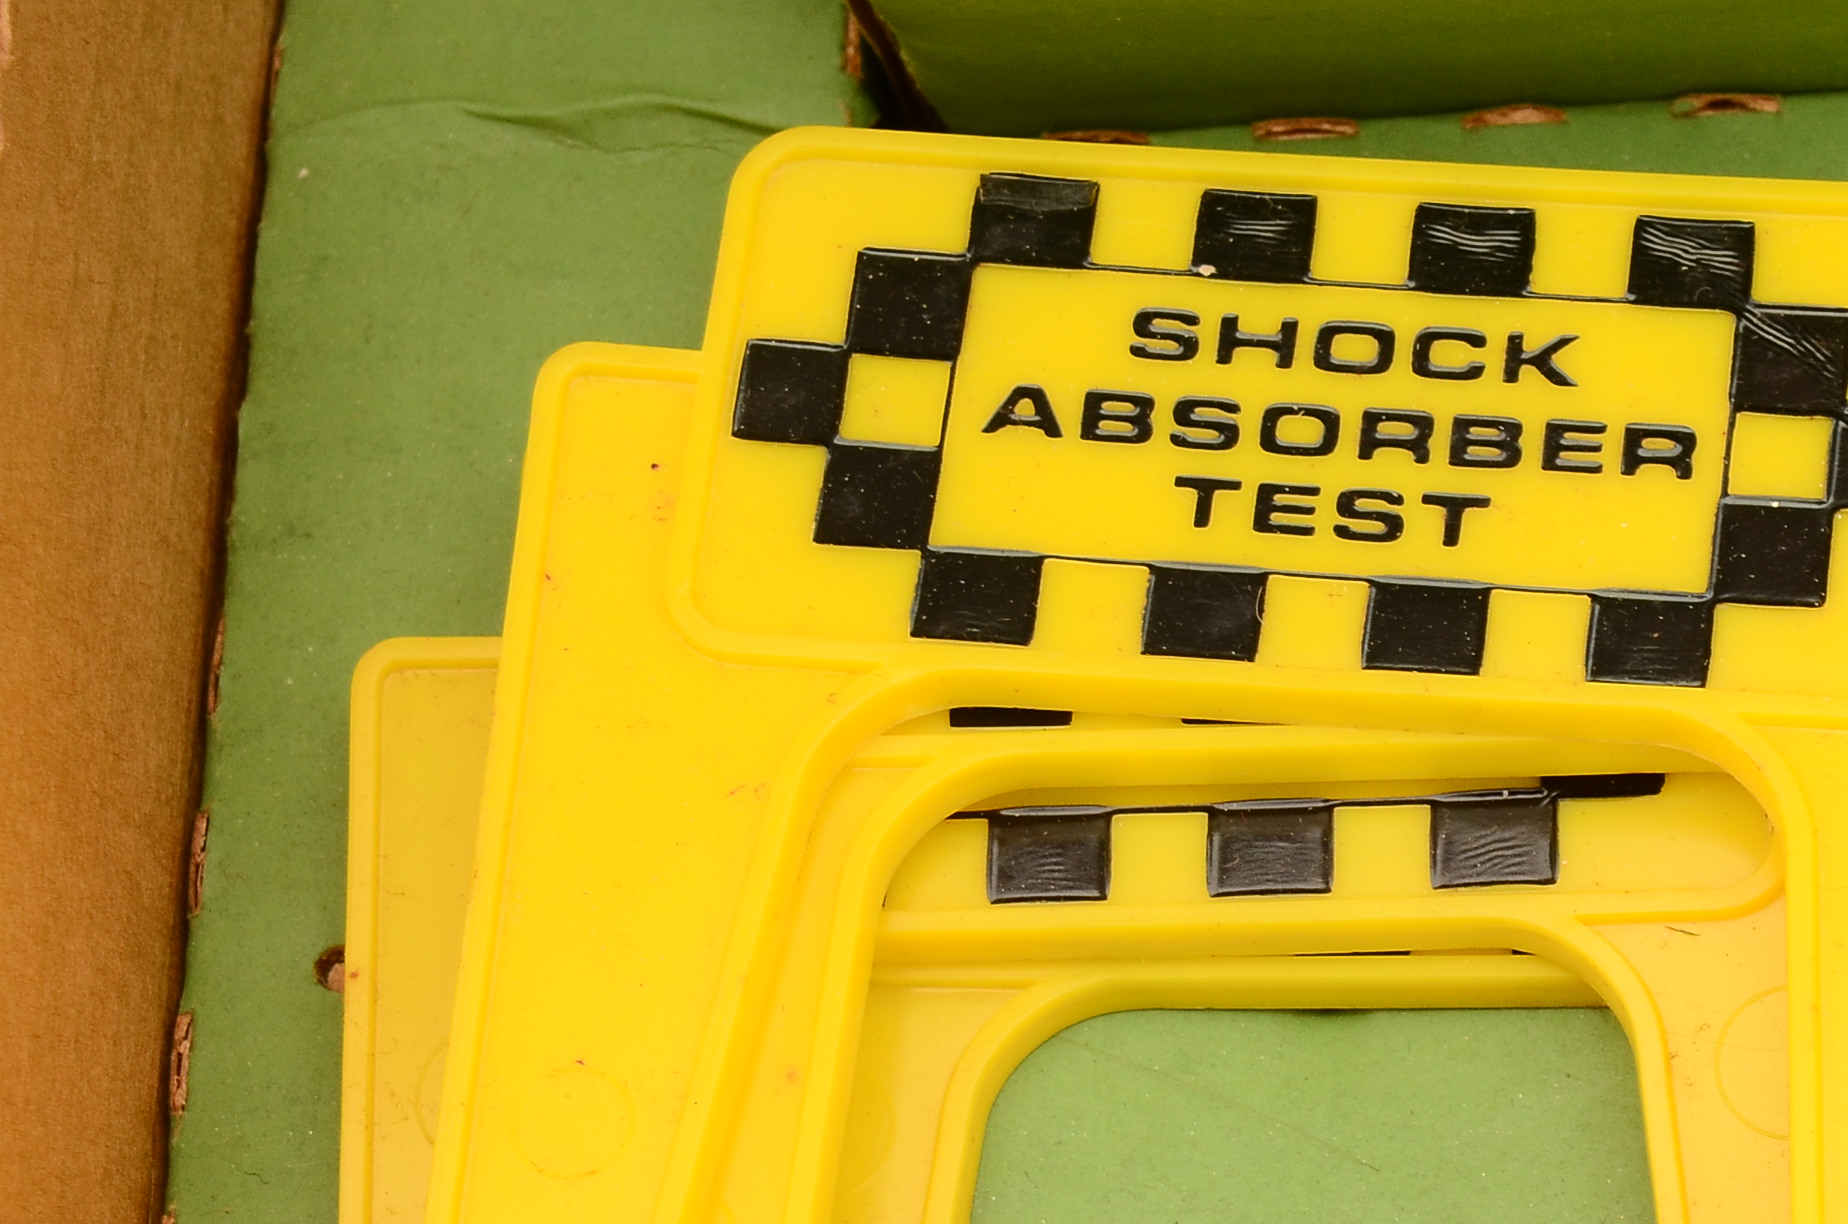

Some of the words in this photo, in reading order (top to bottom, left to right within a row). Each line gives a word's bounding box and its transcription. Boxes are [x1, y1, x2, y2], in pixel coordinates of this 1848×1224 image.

[1127, 307, 1580, 388] SHOCK
[980, 384, 1698, 481] ABSORBER
[1172, 474, 1492, 549] TEST
